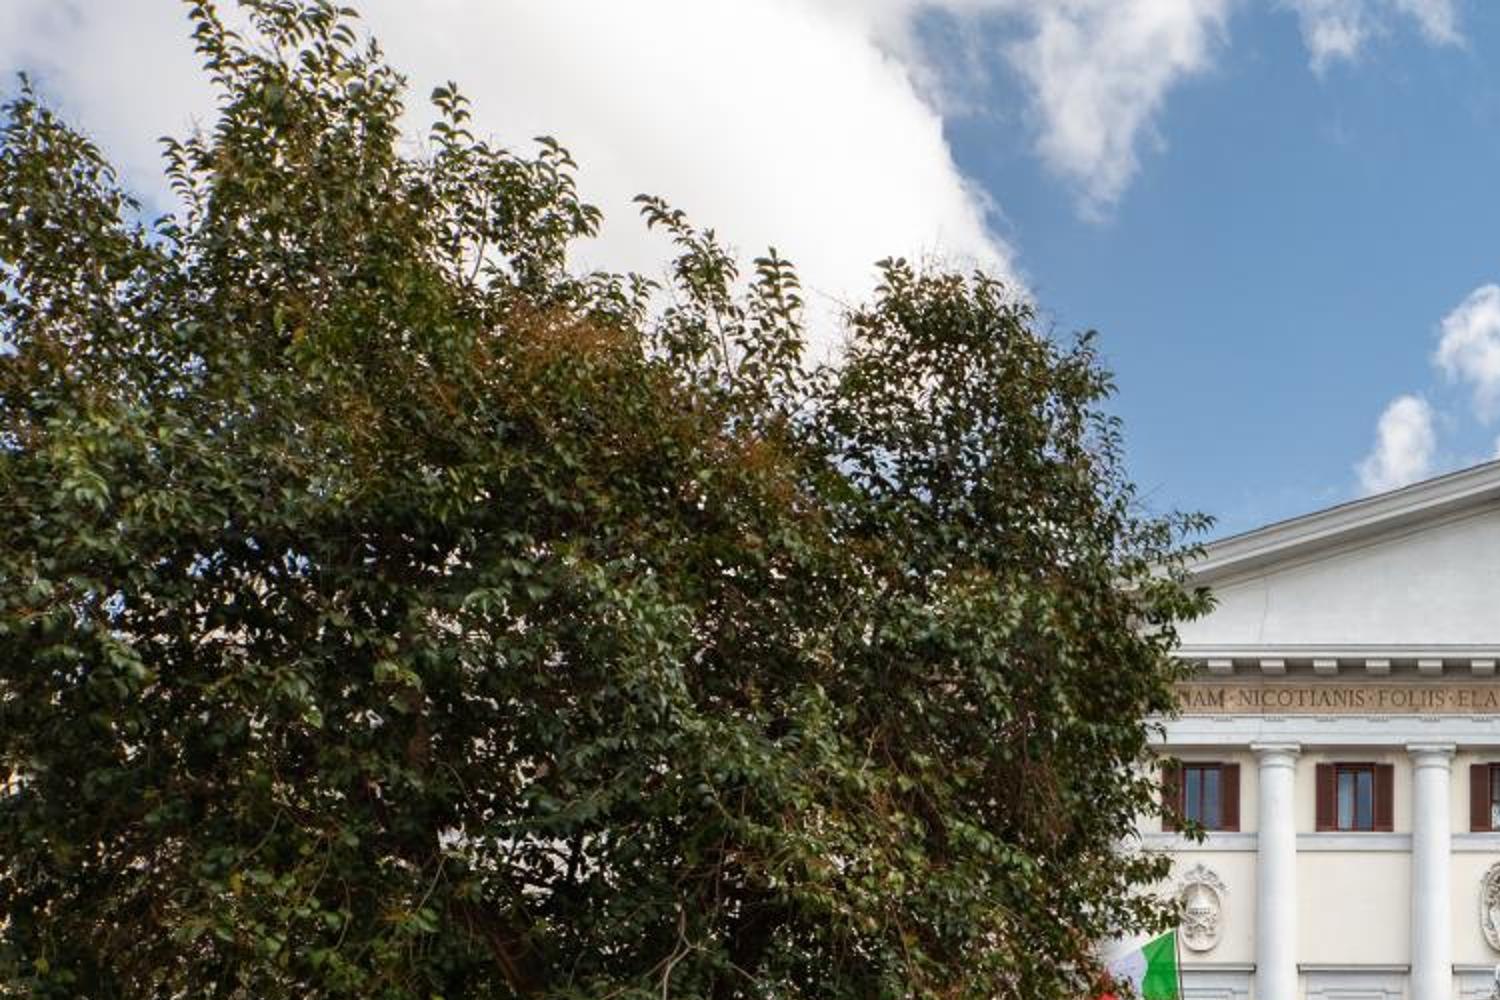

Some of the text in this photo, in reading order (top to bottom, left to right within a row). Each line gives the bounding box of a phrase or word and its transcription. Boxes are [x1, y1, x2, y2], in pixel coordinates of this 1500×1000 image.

[1175, 688, 1225, 707] NAM
[1238, 688, 1365, 707] NICOTIANIS
[1377, 688, 1446, 707] FOLIIS
